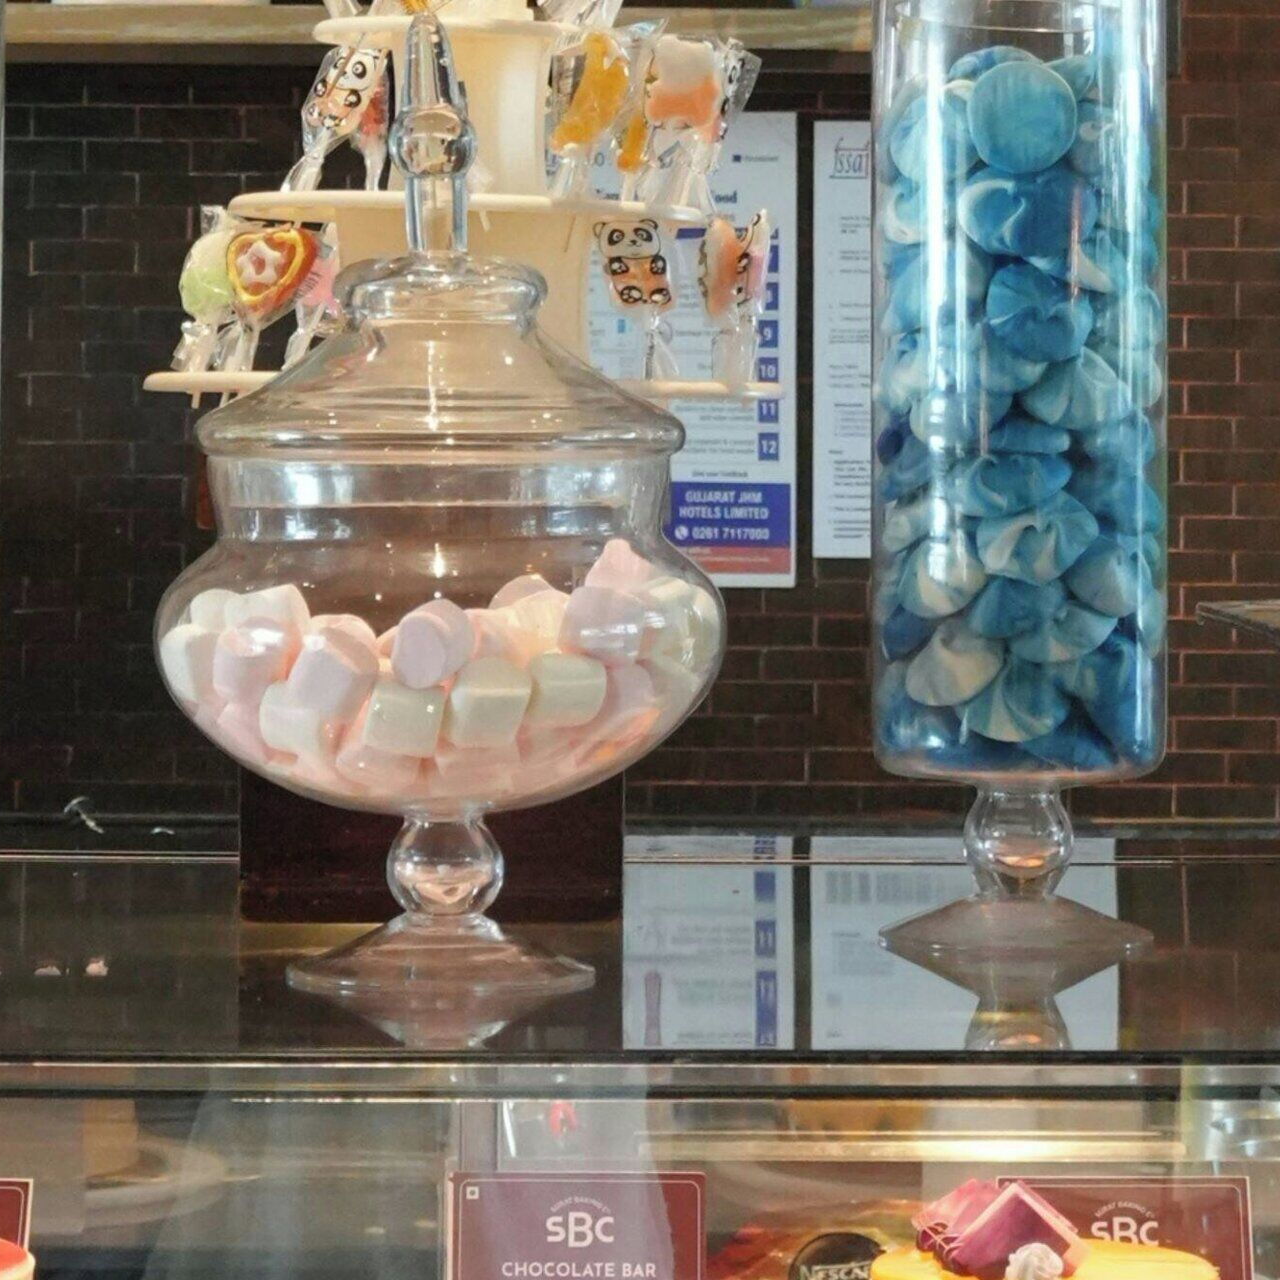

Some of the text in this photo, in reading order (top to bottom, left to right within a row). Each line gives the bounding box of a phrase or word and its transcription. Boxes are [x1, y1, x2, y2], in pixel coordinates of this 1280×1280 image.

[760, 365, 776, 379] 10
[761, 402, 776, 416] 11
[761, 439, 776, 454] 12
[685, 490, 735, 503] GUJARAT
[679, 506, 769, 519] HOTELS LIMITED
[546, 1211, 614, 1248] SBC
[1091, 1216, 1159, 1247] SBC
[502, 1262, 657, 1279] CHOCOLATE BAR
